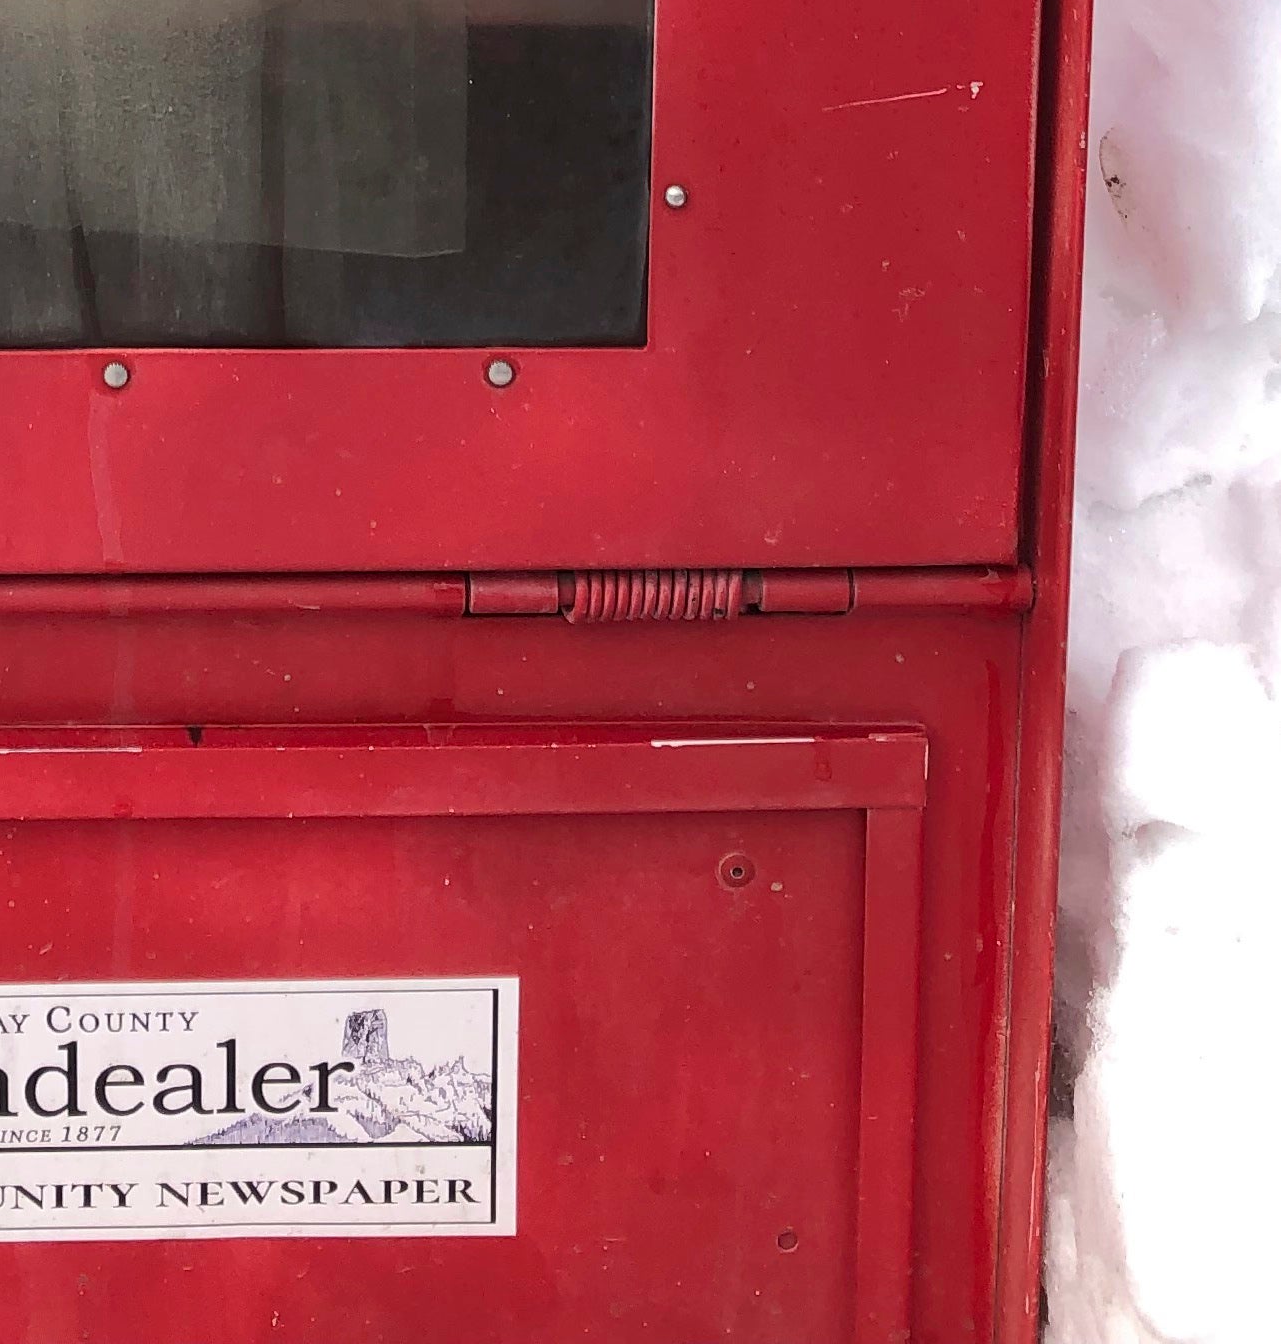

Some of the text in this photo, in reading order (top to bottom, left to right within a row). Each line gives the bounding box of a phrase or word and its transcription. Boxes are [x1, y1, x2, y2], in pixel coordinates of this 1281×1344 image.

[46, 1005, 199, 1033] COUNTY
[61, 1124, 122, 1143] 1877
[156, 1179, 480, 1207] NEWSPAPER
